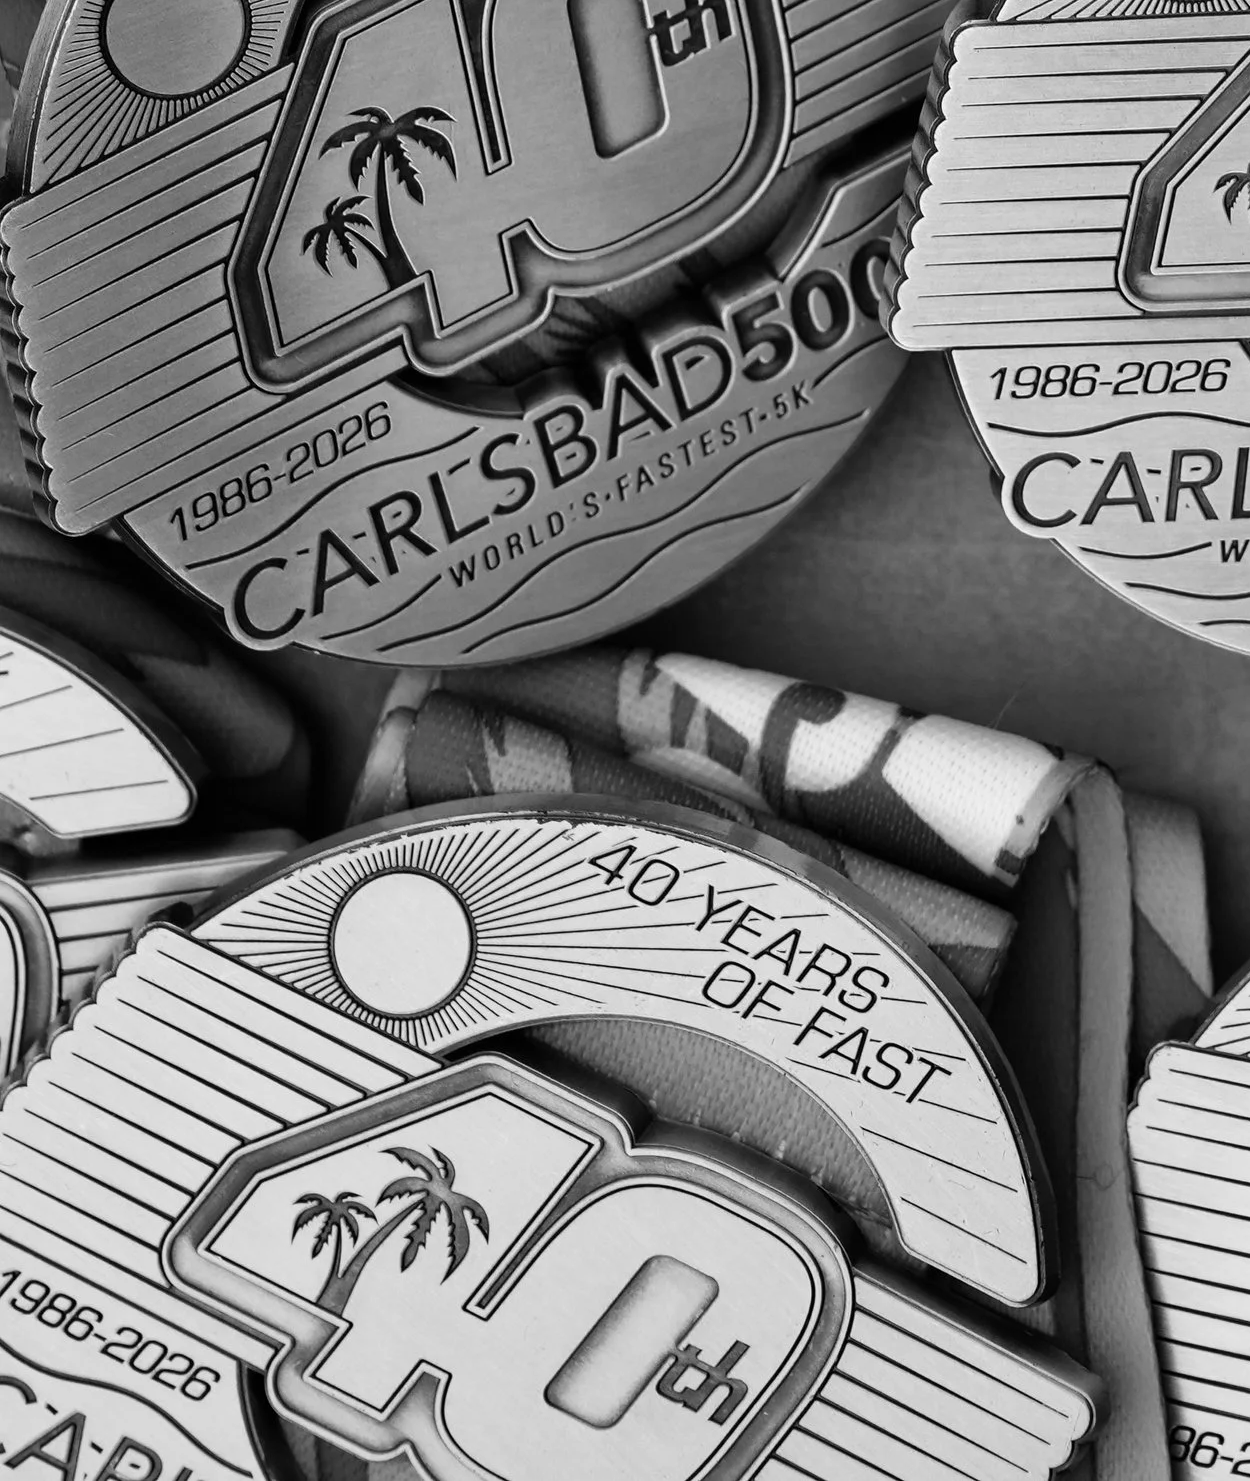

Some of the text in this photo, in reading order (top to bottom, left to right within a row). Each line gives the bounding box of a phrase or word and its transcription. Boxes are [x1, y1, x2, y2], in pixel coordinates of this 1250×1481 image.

[990, 360, 1231, 401] 1986-2026
[170, 399, 391, 539] 1986-2026
[588, 845, 891, 1014] 40 YEARS
[703, 963, 952, 1105] OF FAST
